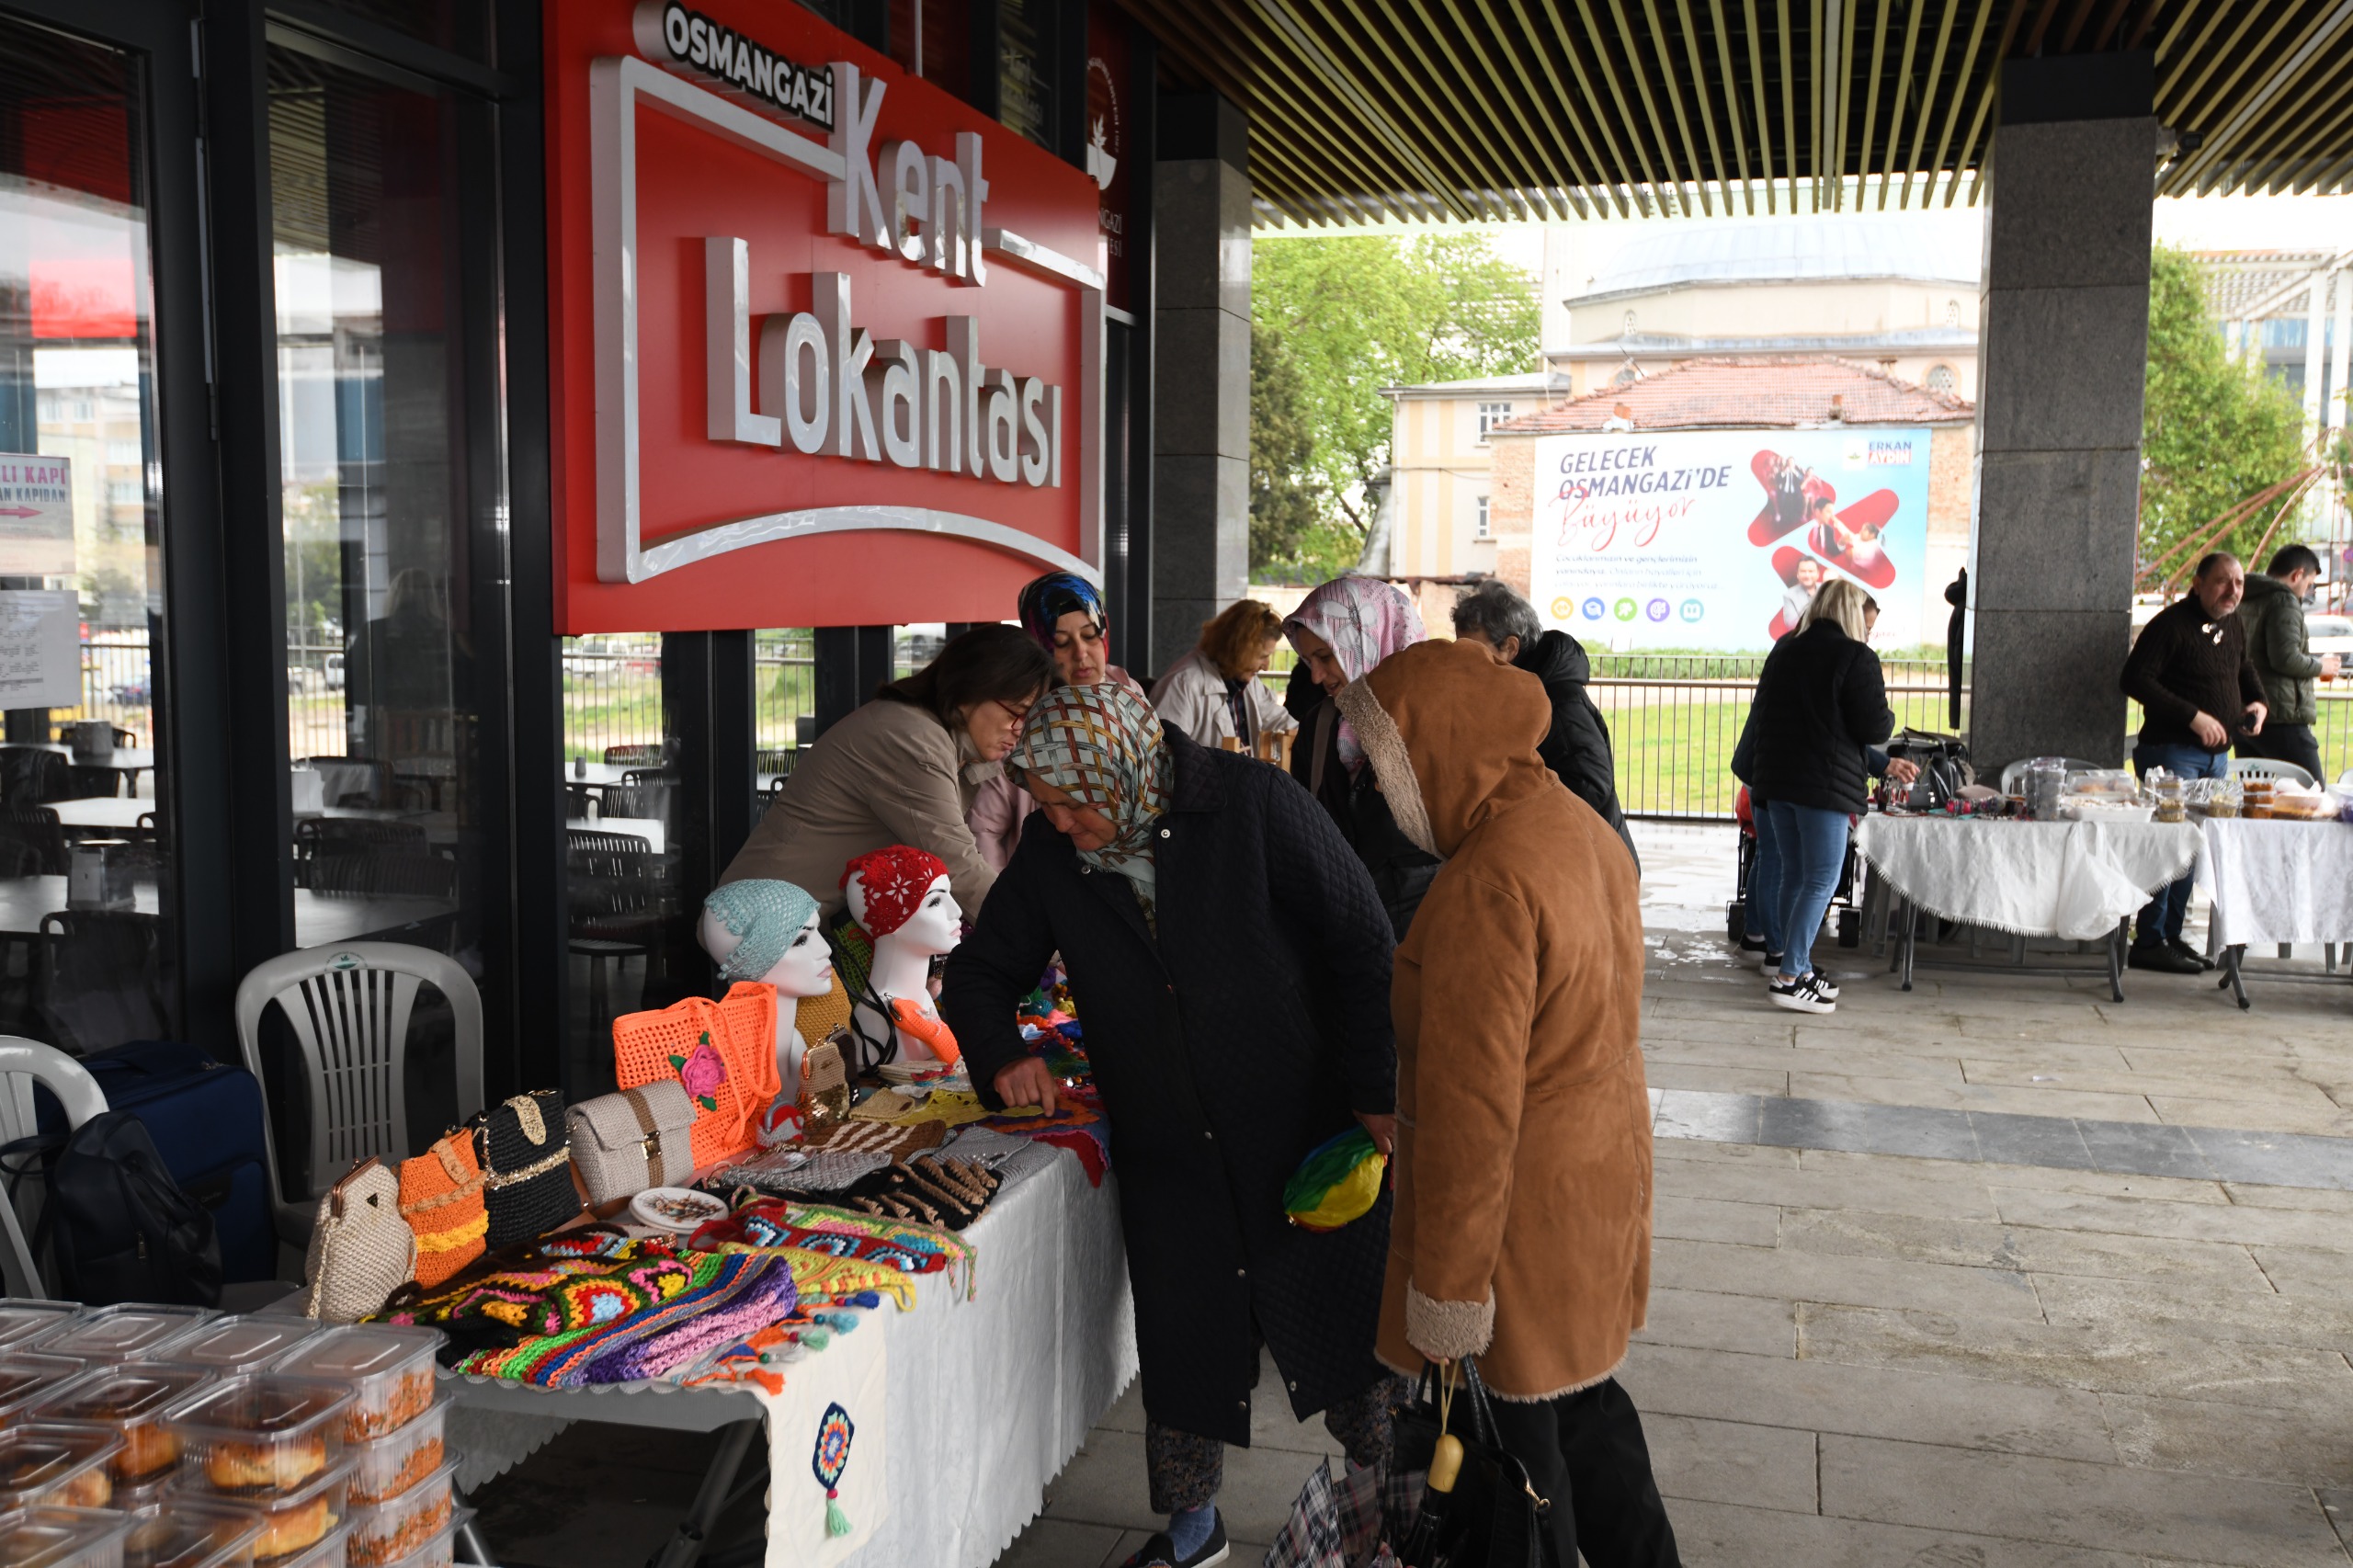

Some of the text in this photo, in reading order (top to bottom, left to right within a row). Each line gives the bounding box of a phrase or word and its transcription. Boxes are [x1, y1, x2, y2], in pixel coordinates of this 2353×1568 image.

[665, 6, 834, 127] OSMANGAZİ
[844, 62, 989, 288] Kent
[726, 236, 1062, 488] Lokantası
[1560, 445, 1657, 474] GELECEK
[1868, 450, 1912, 463] AYDIN
[1869, 440, 1912, 451] ERKAN
[25, 465, 66, 485] KAPI
[1559, 465, 1733, 500] OSMANGAZİ'DE
[16, 487, 66, 503] KAPIDAN
[1548, 484, 1696, 551] Büyüyor
